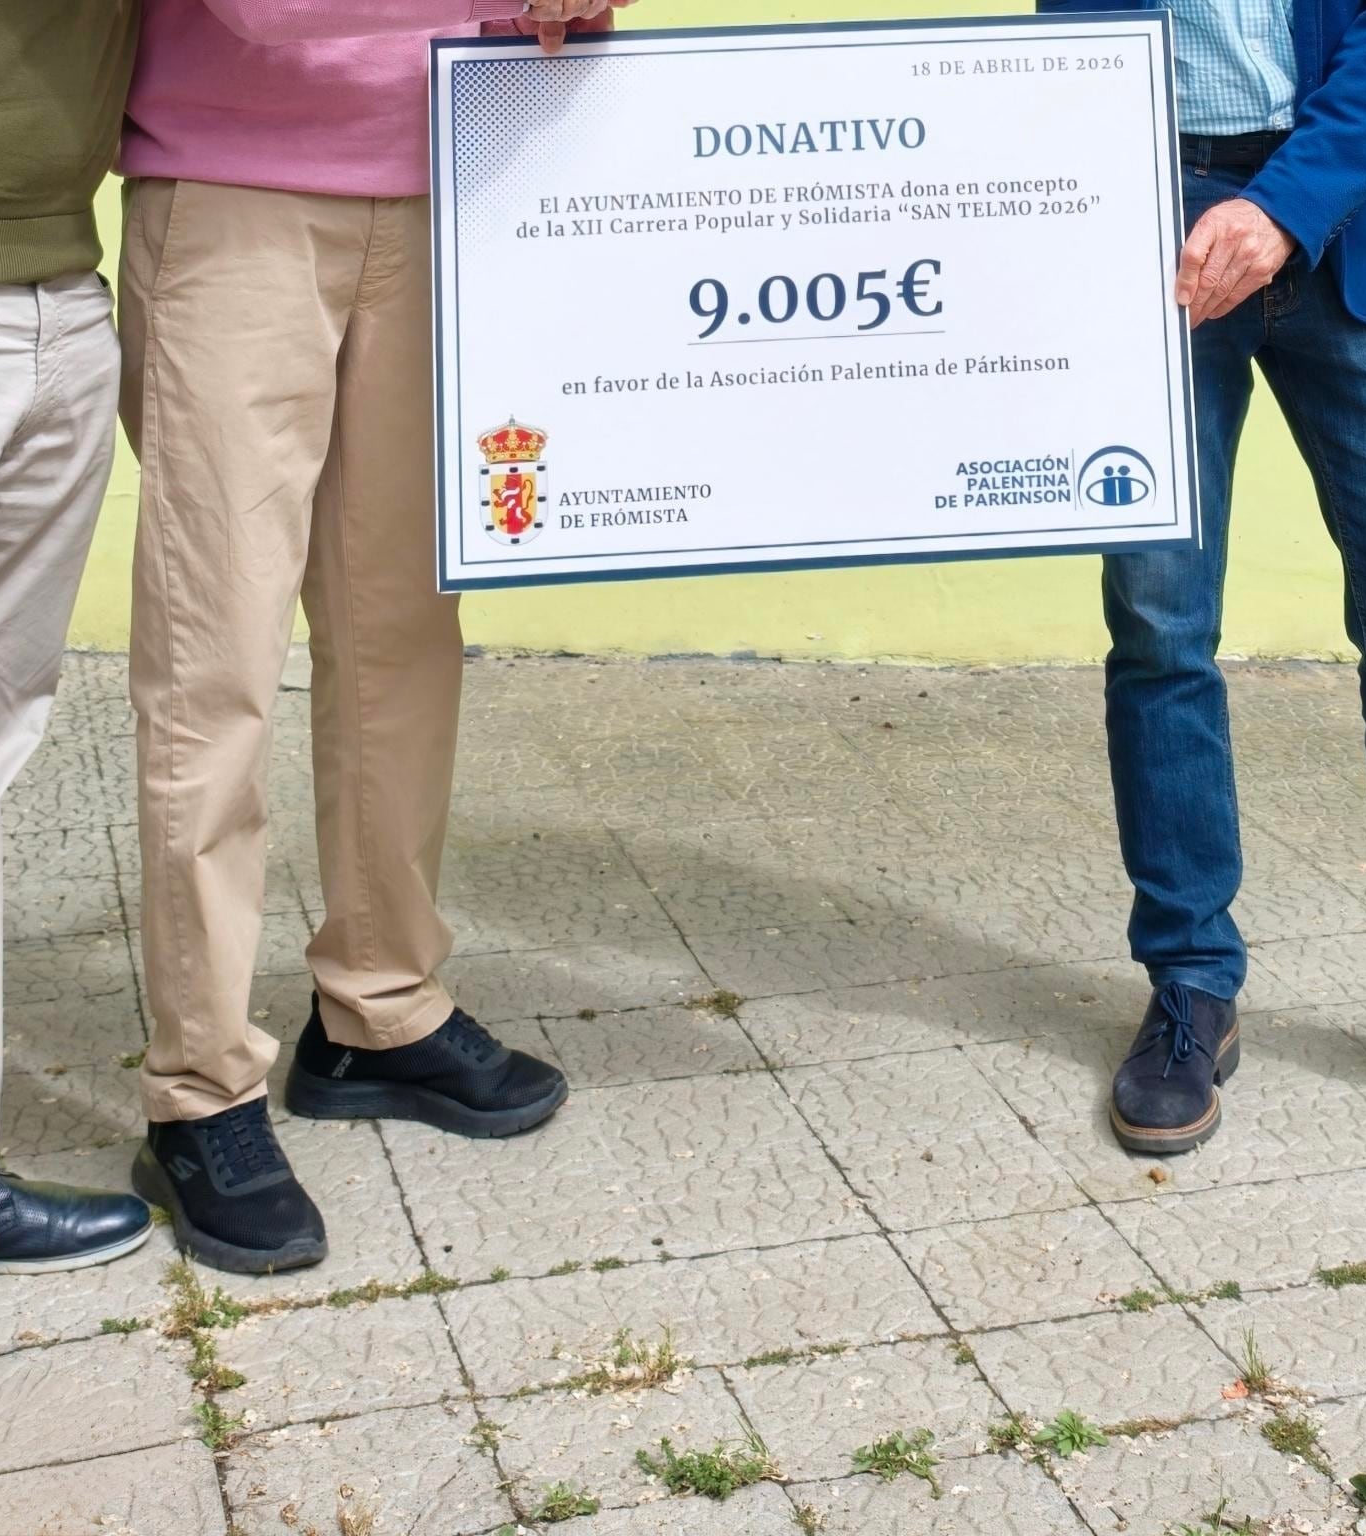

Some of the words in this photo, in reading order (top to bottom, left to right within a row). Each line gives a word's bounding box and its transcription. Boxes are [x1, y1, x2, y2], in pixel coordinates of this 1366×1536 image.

[911, 61, 931, 76] 18
[939, 60, 965, 75] DE
[972, 58, 1035, 74] ABRIL
[1042, 56, 1069, 72] DE
[1076, 54, 1124, 71] 2026
[692, 117, 926, 158] DONATIVO
[539, 197, 559, 214] El
[566, 189, 742, 213] AYUNTAMIENTO
[748, 187, 777, 204] DE
[783, 182, 895, 203] FRÓMISTA
[901, 181, 950, 198] dona
[956, 182, 980, 195] en
[986, 176, 1078, 196] concepto
[516, 222, 540, 239] de
[547, 221, 565, 237] la
[571, 219, 603, 236] XII
[609, 217, 688, 234] Carrera
[695, 210, 775, 233] Popular
[782, 213, 793, 230] y
[799, 206, 891, 225] Solidaria
[957, 200, 1032, 218] TELMO
[689, 259, 943, 339] 9.005€
[562, 381, 586, 395] en
[594, 376, 649, 393] favor
[656, 373, 679, 389] de
[686, 371, 703, 388] la
[710, 364, 823, 387] Asociación
[831, 360, 929, 381] Palentina
[935, 359, 958, 375] de
[965, 355, 1070, 374] Párkinson
[956, 454, 1068, 476] ASOCIACIÓN
[967, 473, 1069, 491] PALENTINA
[559, 484, 712, 506] AYUNTAMIENTO
[935, 495, 957, 509] DE
[964, 489, 1070, 507] PARKINSON
[560, 514, 585, 529] DE
[590, 508, 688, 527] FRÓMISTA
